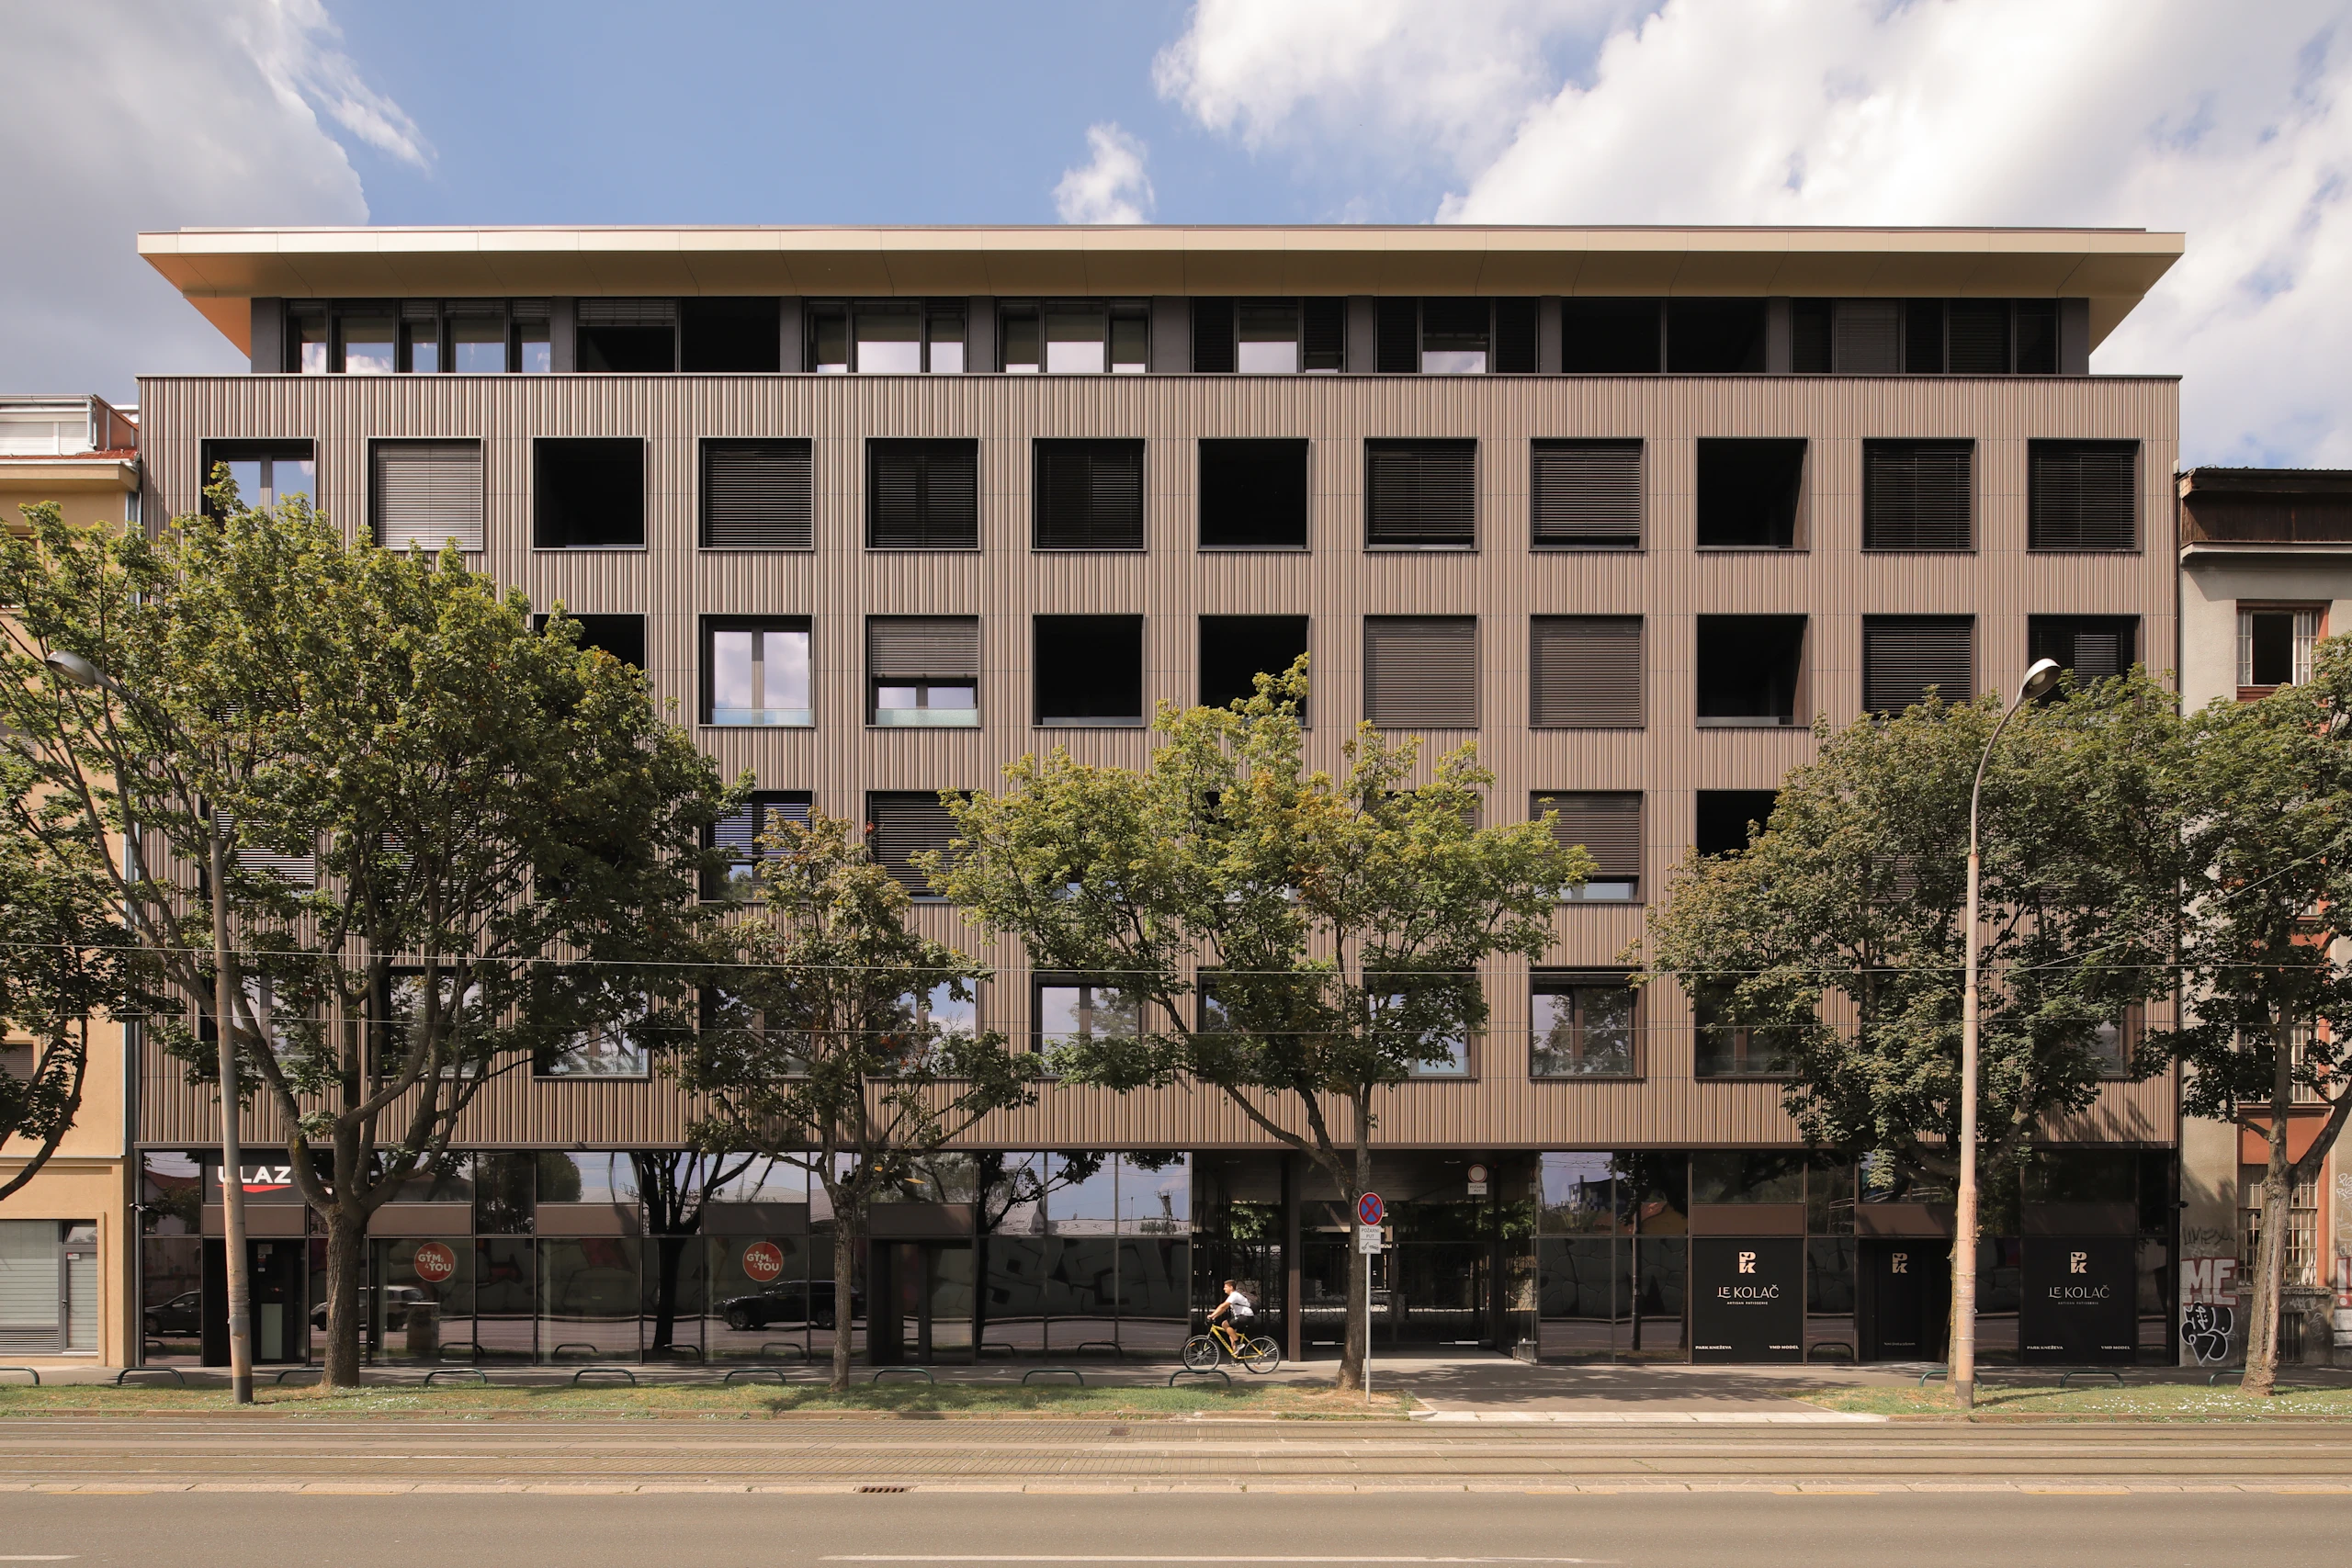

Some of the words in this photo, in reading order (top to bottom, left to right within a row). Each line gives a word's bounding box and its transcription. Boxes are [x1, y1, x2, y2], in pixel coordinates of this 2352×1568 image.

[1717, 1286, 1732, 1298] LE
[1734, 1284, 1780, 1299] KOLAČ
[2048, 1286, 2063, 1298] LE
[2064, 1284, 2110, 1299] KOLAČ
